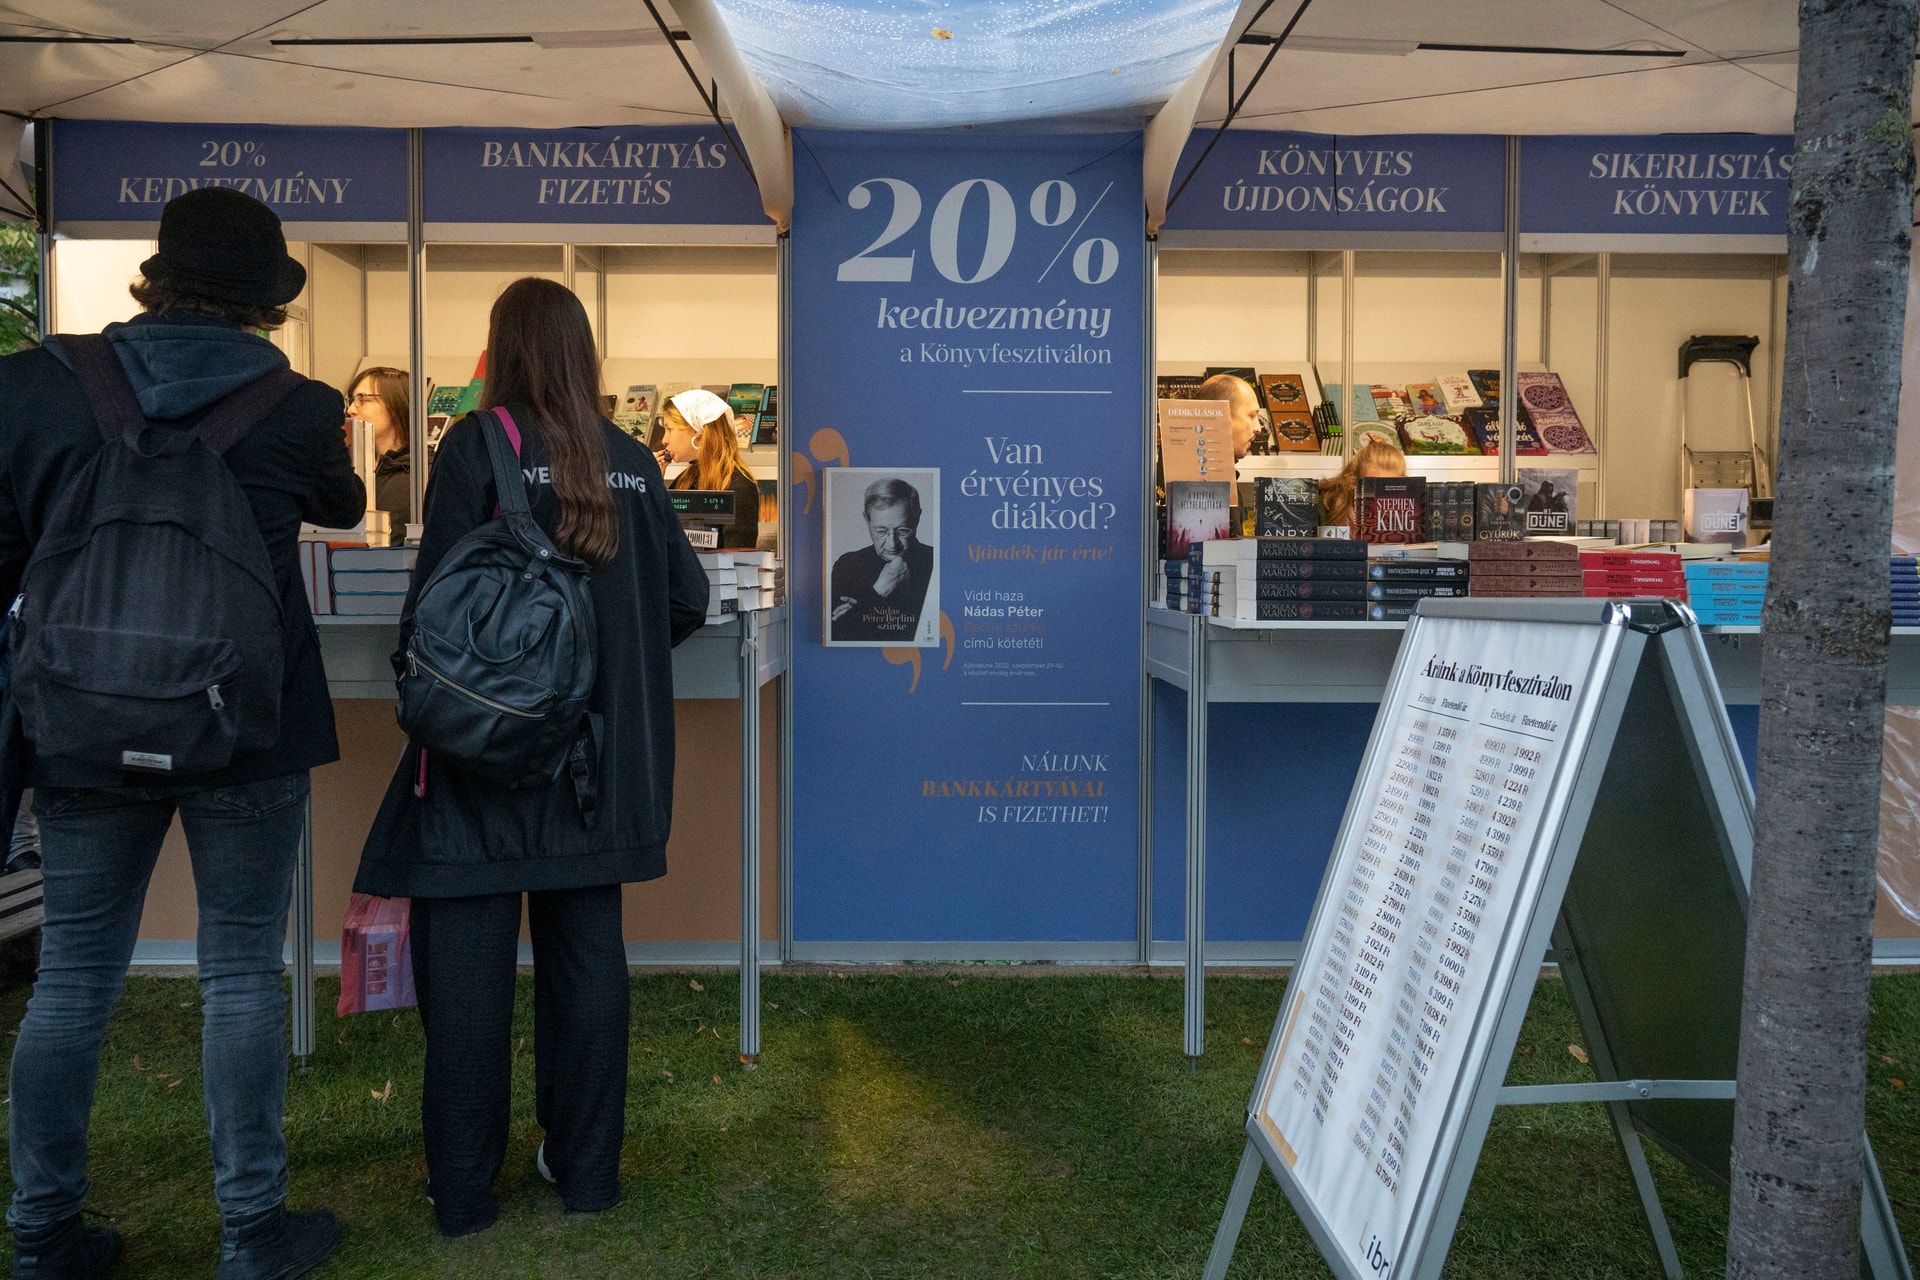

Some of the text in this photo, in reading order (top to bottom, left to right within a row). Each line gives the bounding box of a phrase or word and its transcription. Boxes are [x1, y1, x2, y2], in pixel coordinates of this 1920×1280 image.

[200, 141, 266, 167] 20%
[481, 135, 727, 169] BANKKÁRTYÁS
[1257, 144, 1413, 176] KÖNYVES
[1588, 147, 1794, 180] SIKERLISTÁS
[537, 173, 672, 205] FIZETÉS
[1223, 178, 1449, 213] ÚJDONSÁGOK
[1612, 184, 1773, 216] KÖNYVEK
[836, 177, 1120, 285] 20%
[877, 297, 1112, 338] kedvezmény
[900, 342, 1112, 368] a Könyvfesztiválon
[1168, 407, 1224, 417] DEDIKÁLÁSOK
[984, 437, 1044, 464] Van
[605, 471, 646, 493] KING
[960, 469, 1104, 504] érvényes
[1264, 494, 1309, 502] MARY
[1376, 498, 1415, 510] STEPHEN
[991, 501, 1116, 530] diákod?
[1376, 510, 1415, 531] KING
[1264, 529, 1309, 537] ANDY
[968, 543, 1113, 564] Ajándék jár érte!
[1262, 548, 1298, 556] MARTIN
[1261, 569, 1297, 577] MARTIN
[964, 590, 1024, 601] Vidd haza
[1260, 589, 1297, 597] MARTIN
[964, 606, 1043, 617] Nádas Péter
[1261, 609, 1297, 617] MARTIN
[964, 637, 1043, 649] című kötetét!
[1420, 654, 1573, 701] Áraink a Könyvfesztiválon
[1021, 751, 1109, 772] NÁLUNK
[922, 776, 1109, 797] BANKKÁRTYÁVAL
[977, 806, 1109, 823] IS FIZETHET!
